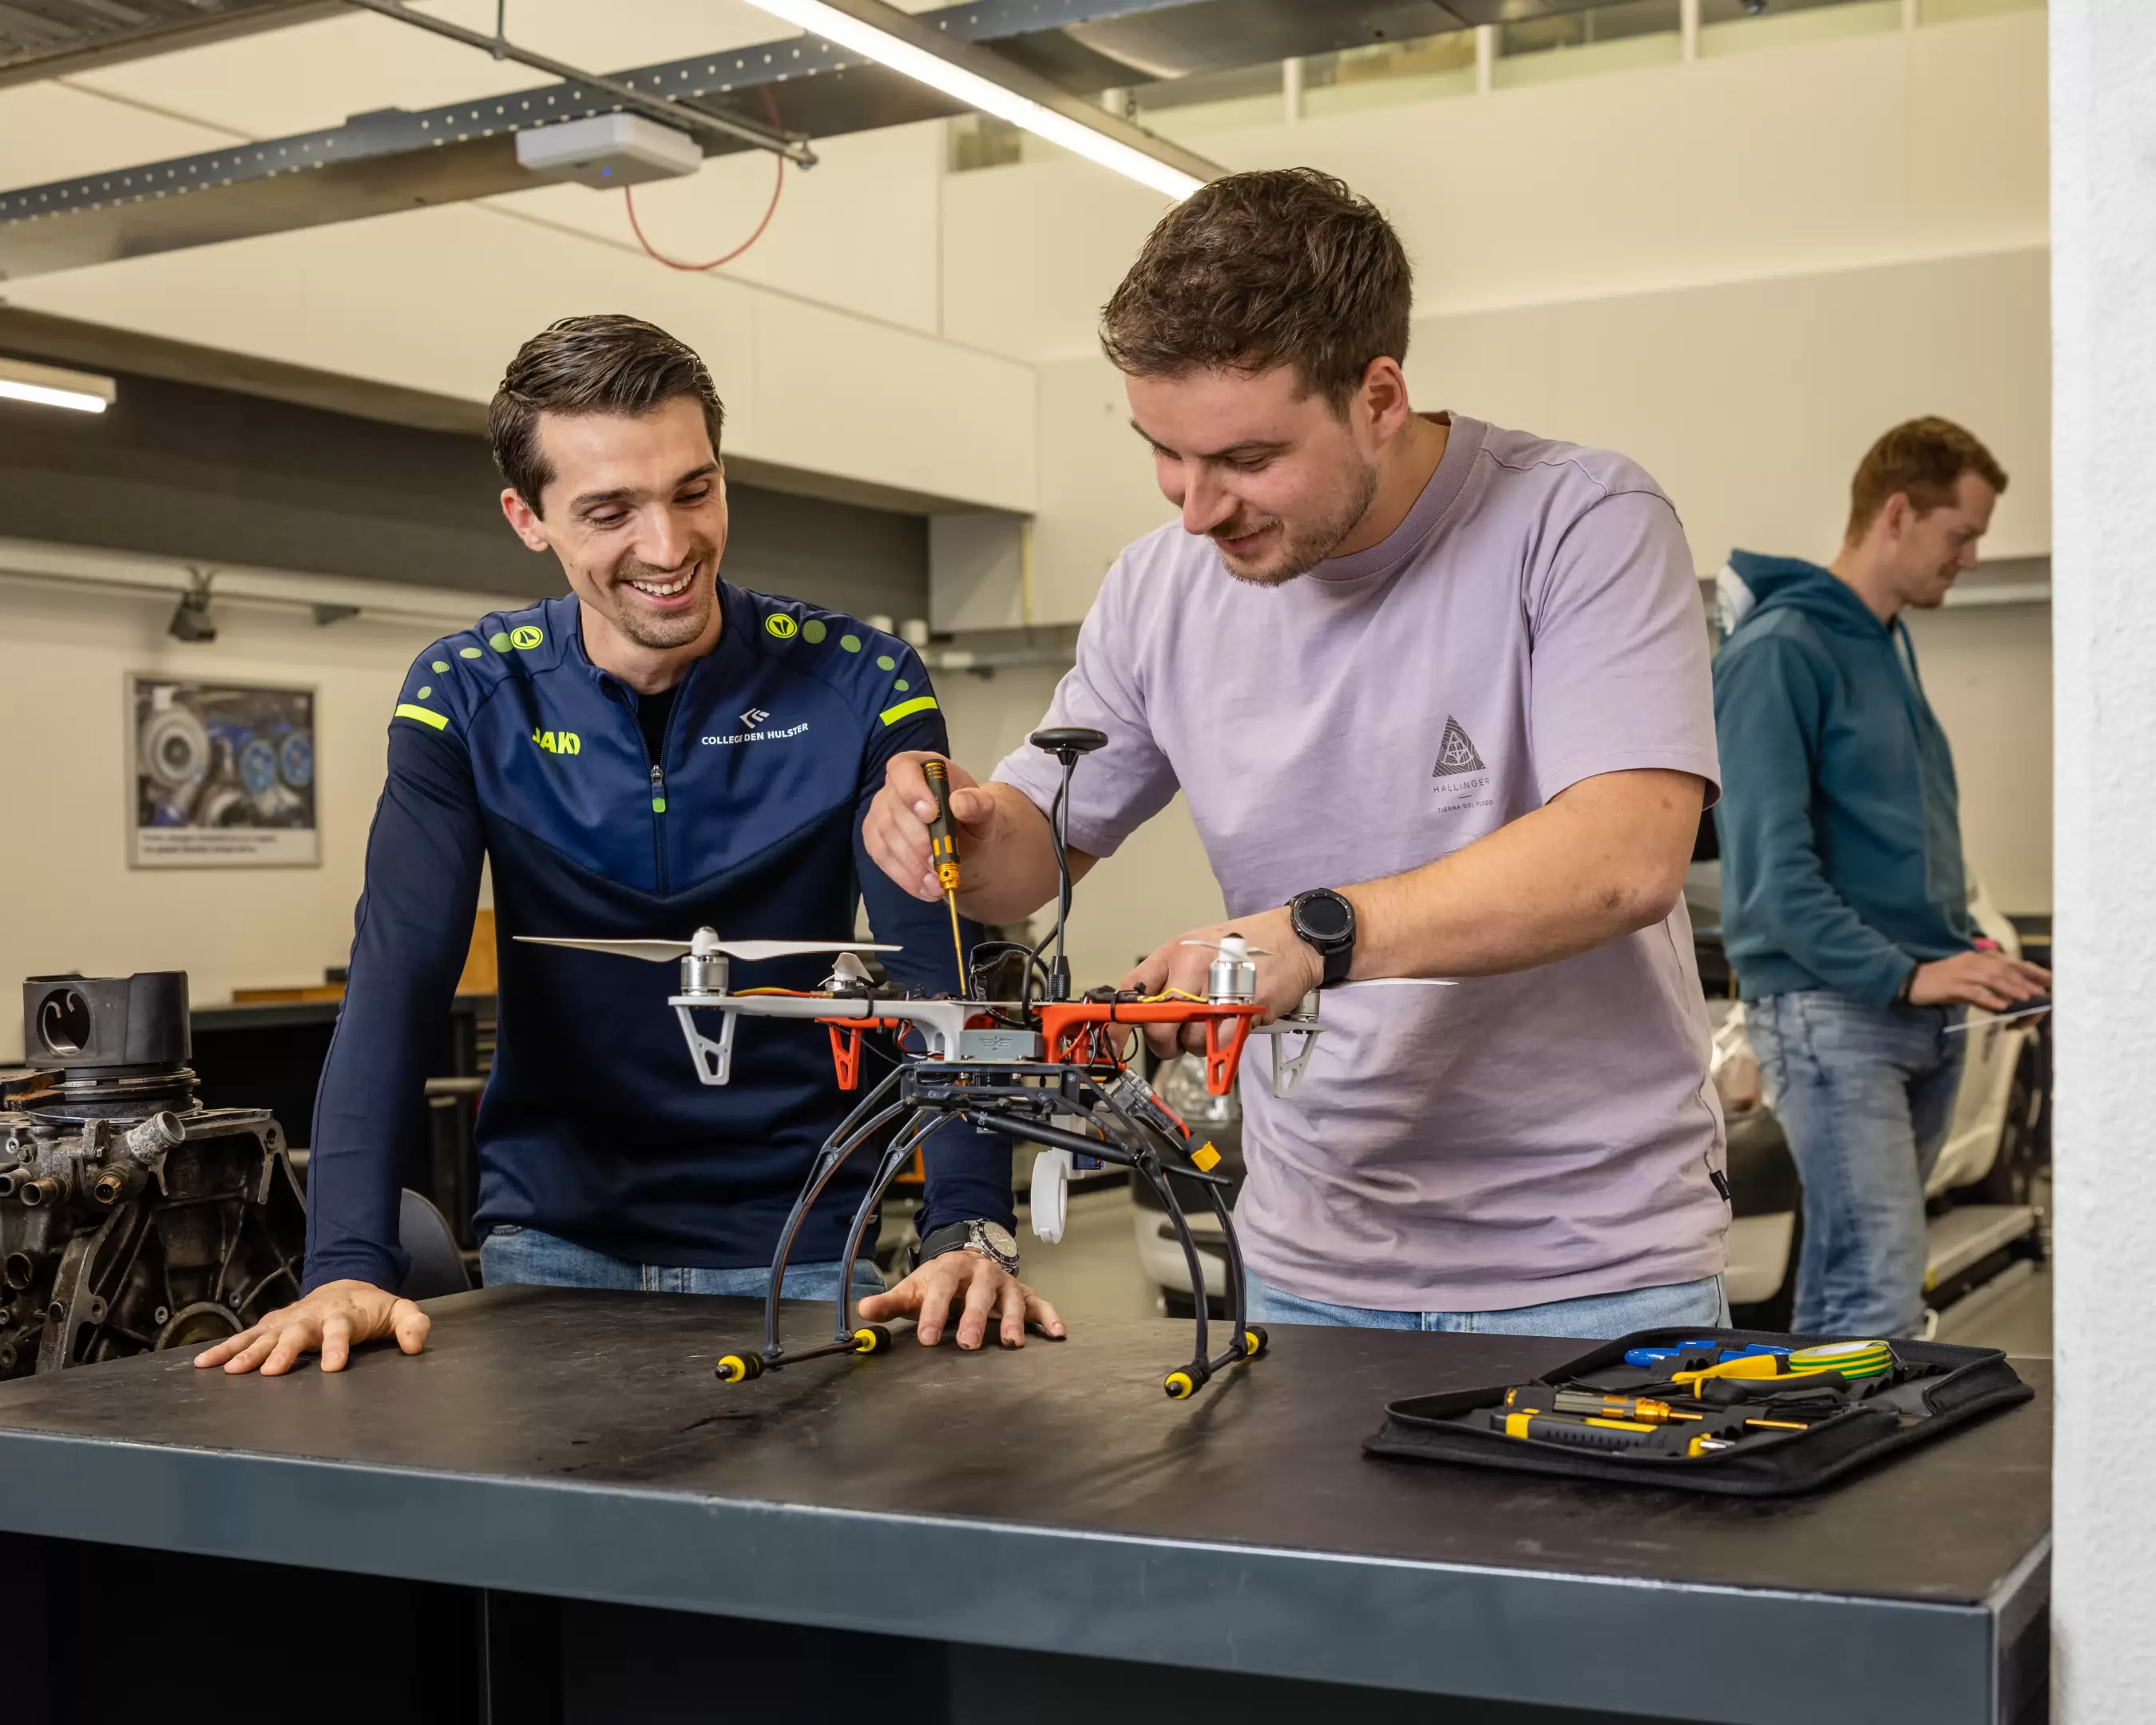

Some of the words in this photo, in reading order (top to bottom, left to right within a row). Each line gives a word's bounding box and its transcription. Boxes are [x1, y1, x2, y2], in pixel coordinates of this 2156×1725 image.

[533, 728, 581, 755] JAKO
[702, 736, 743, 745] COLLEGE
[744, 732, 764, 742] DEN
[767, 723, 808, 740] HULSTER
[1433, 778, 1490, 793] HALLINGER
